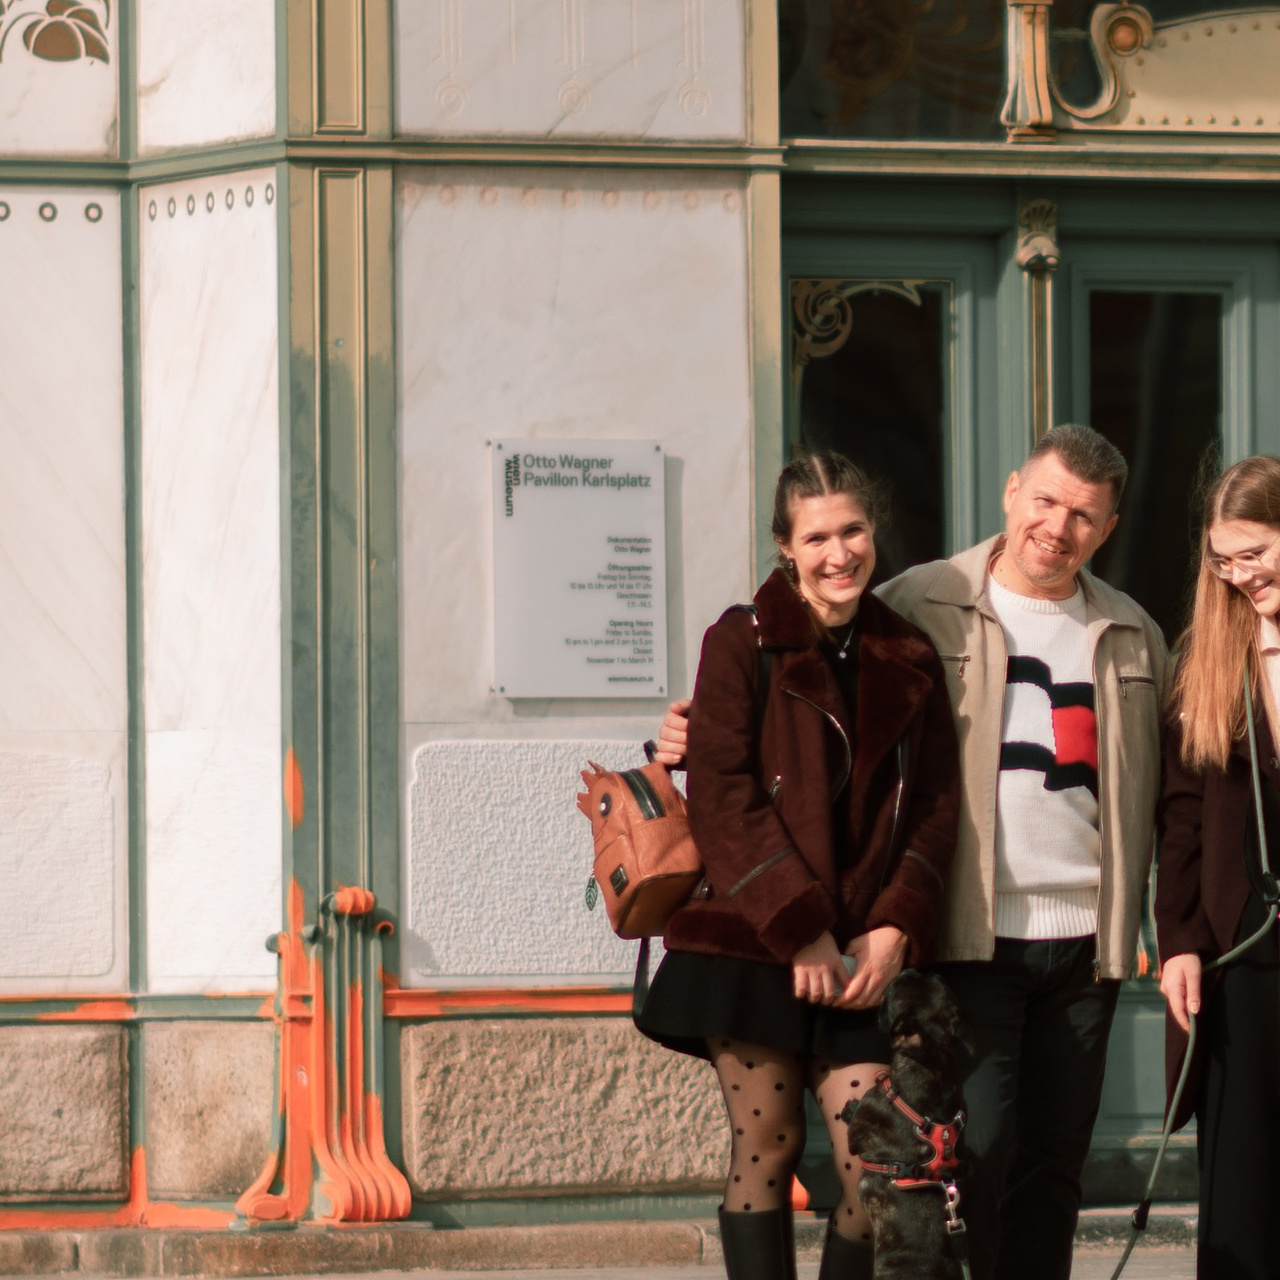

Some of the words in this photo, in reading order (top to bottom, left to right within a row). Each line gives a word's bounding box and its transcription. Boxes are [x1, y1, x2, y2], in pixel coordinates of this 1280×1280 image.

[523, 454, 557, 469] Otto
[559, 454, 614, 472] Wagner
[523, 472, 579, 487] Pavillon
[582, 472, 652, 490] Karlsplatz
